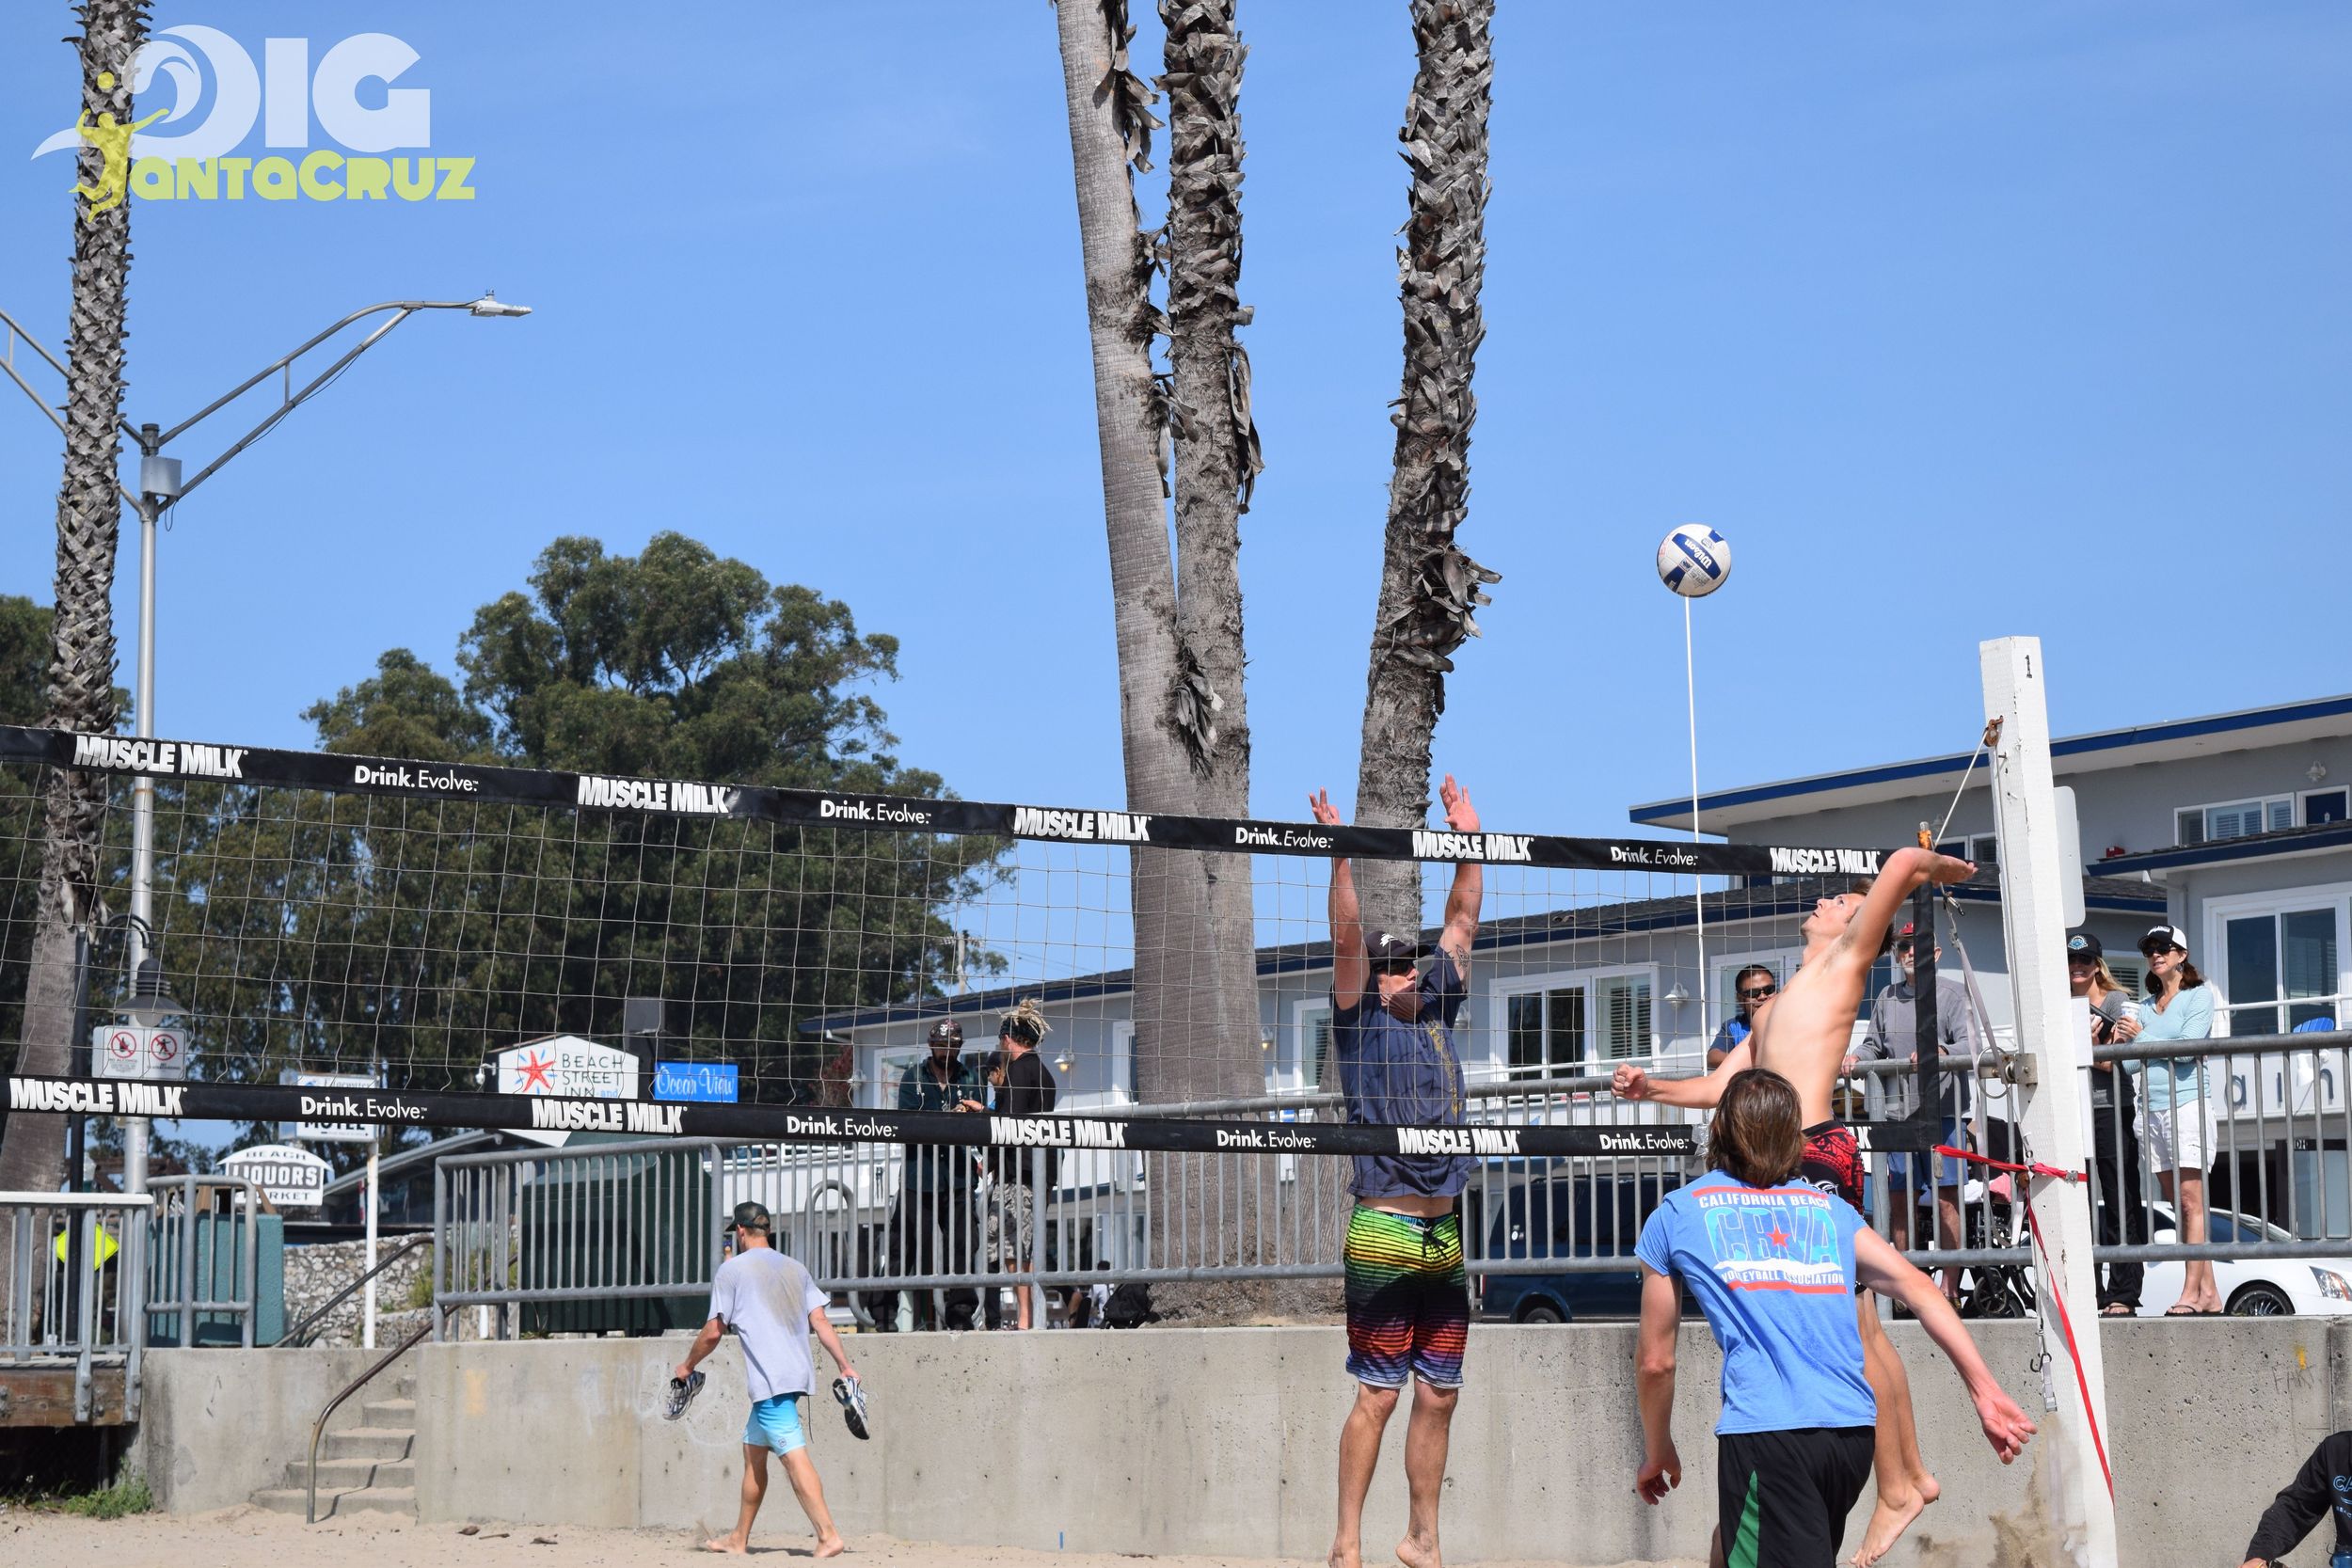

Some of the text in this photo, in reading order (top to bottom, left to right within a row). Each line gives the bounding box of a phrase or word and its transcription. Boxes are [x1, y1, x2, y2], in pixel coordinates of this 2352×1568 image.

[2025, 654, 2033, 679] 1
[73, 736, 243, 779] MUSCLE MILK
[355, 766, 415, 788] Drink.
[578, 776, 728, 814] MUSCLE MILK
[820, 800, 874, 820] Drink.
[1014, 806, 1150, 842] MUSCLE MILK
[1235, 826, 1282, 847] Drink.
[1413, 830, 1532, 862] MUSCLE MILK
[1611, 846, 1653, 863] Drink.
[1770, 847, 1879, 875] MUSCLE MILK
[562, 1053, 624, 1069] BEACH
[562, 1070, 621, 1085] STREET
[658, 1065, 736, 1095] Ocean View
[9, 1078, 183, 1116] MUSCLE MILK
[564, 1086, 595, 1097] INN
[301, 1096, 364, 1117] Drink.
[532, 1099, 683, 1133] MUSCLE MILK
[787, 1116, 842, 1136] Drink.
[991, 1117, 1126, 1148] MUSCLE MILK
[1216, 1129, 1266, 1148] Drink.
[1397, 1127, 1520, 1155] MUSCLE MILK
[1599, 1132, 1645, 1150] Drink.
[246, 1150, 307, 1161] BEACH
[1698, 1193, 1832, 1211] CALIFORNIA BEACH
[1704, 1206, 1842, 1270] CBVA
[1783, 1272, 1845, 1286] ASSOCIATION
